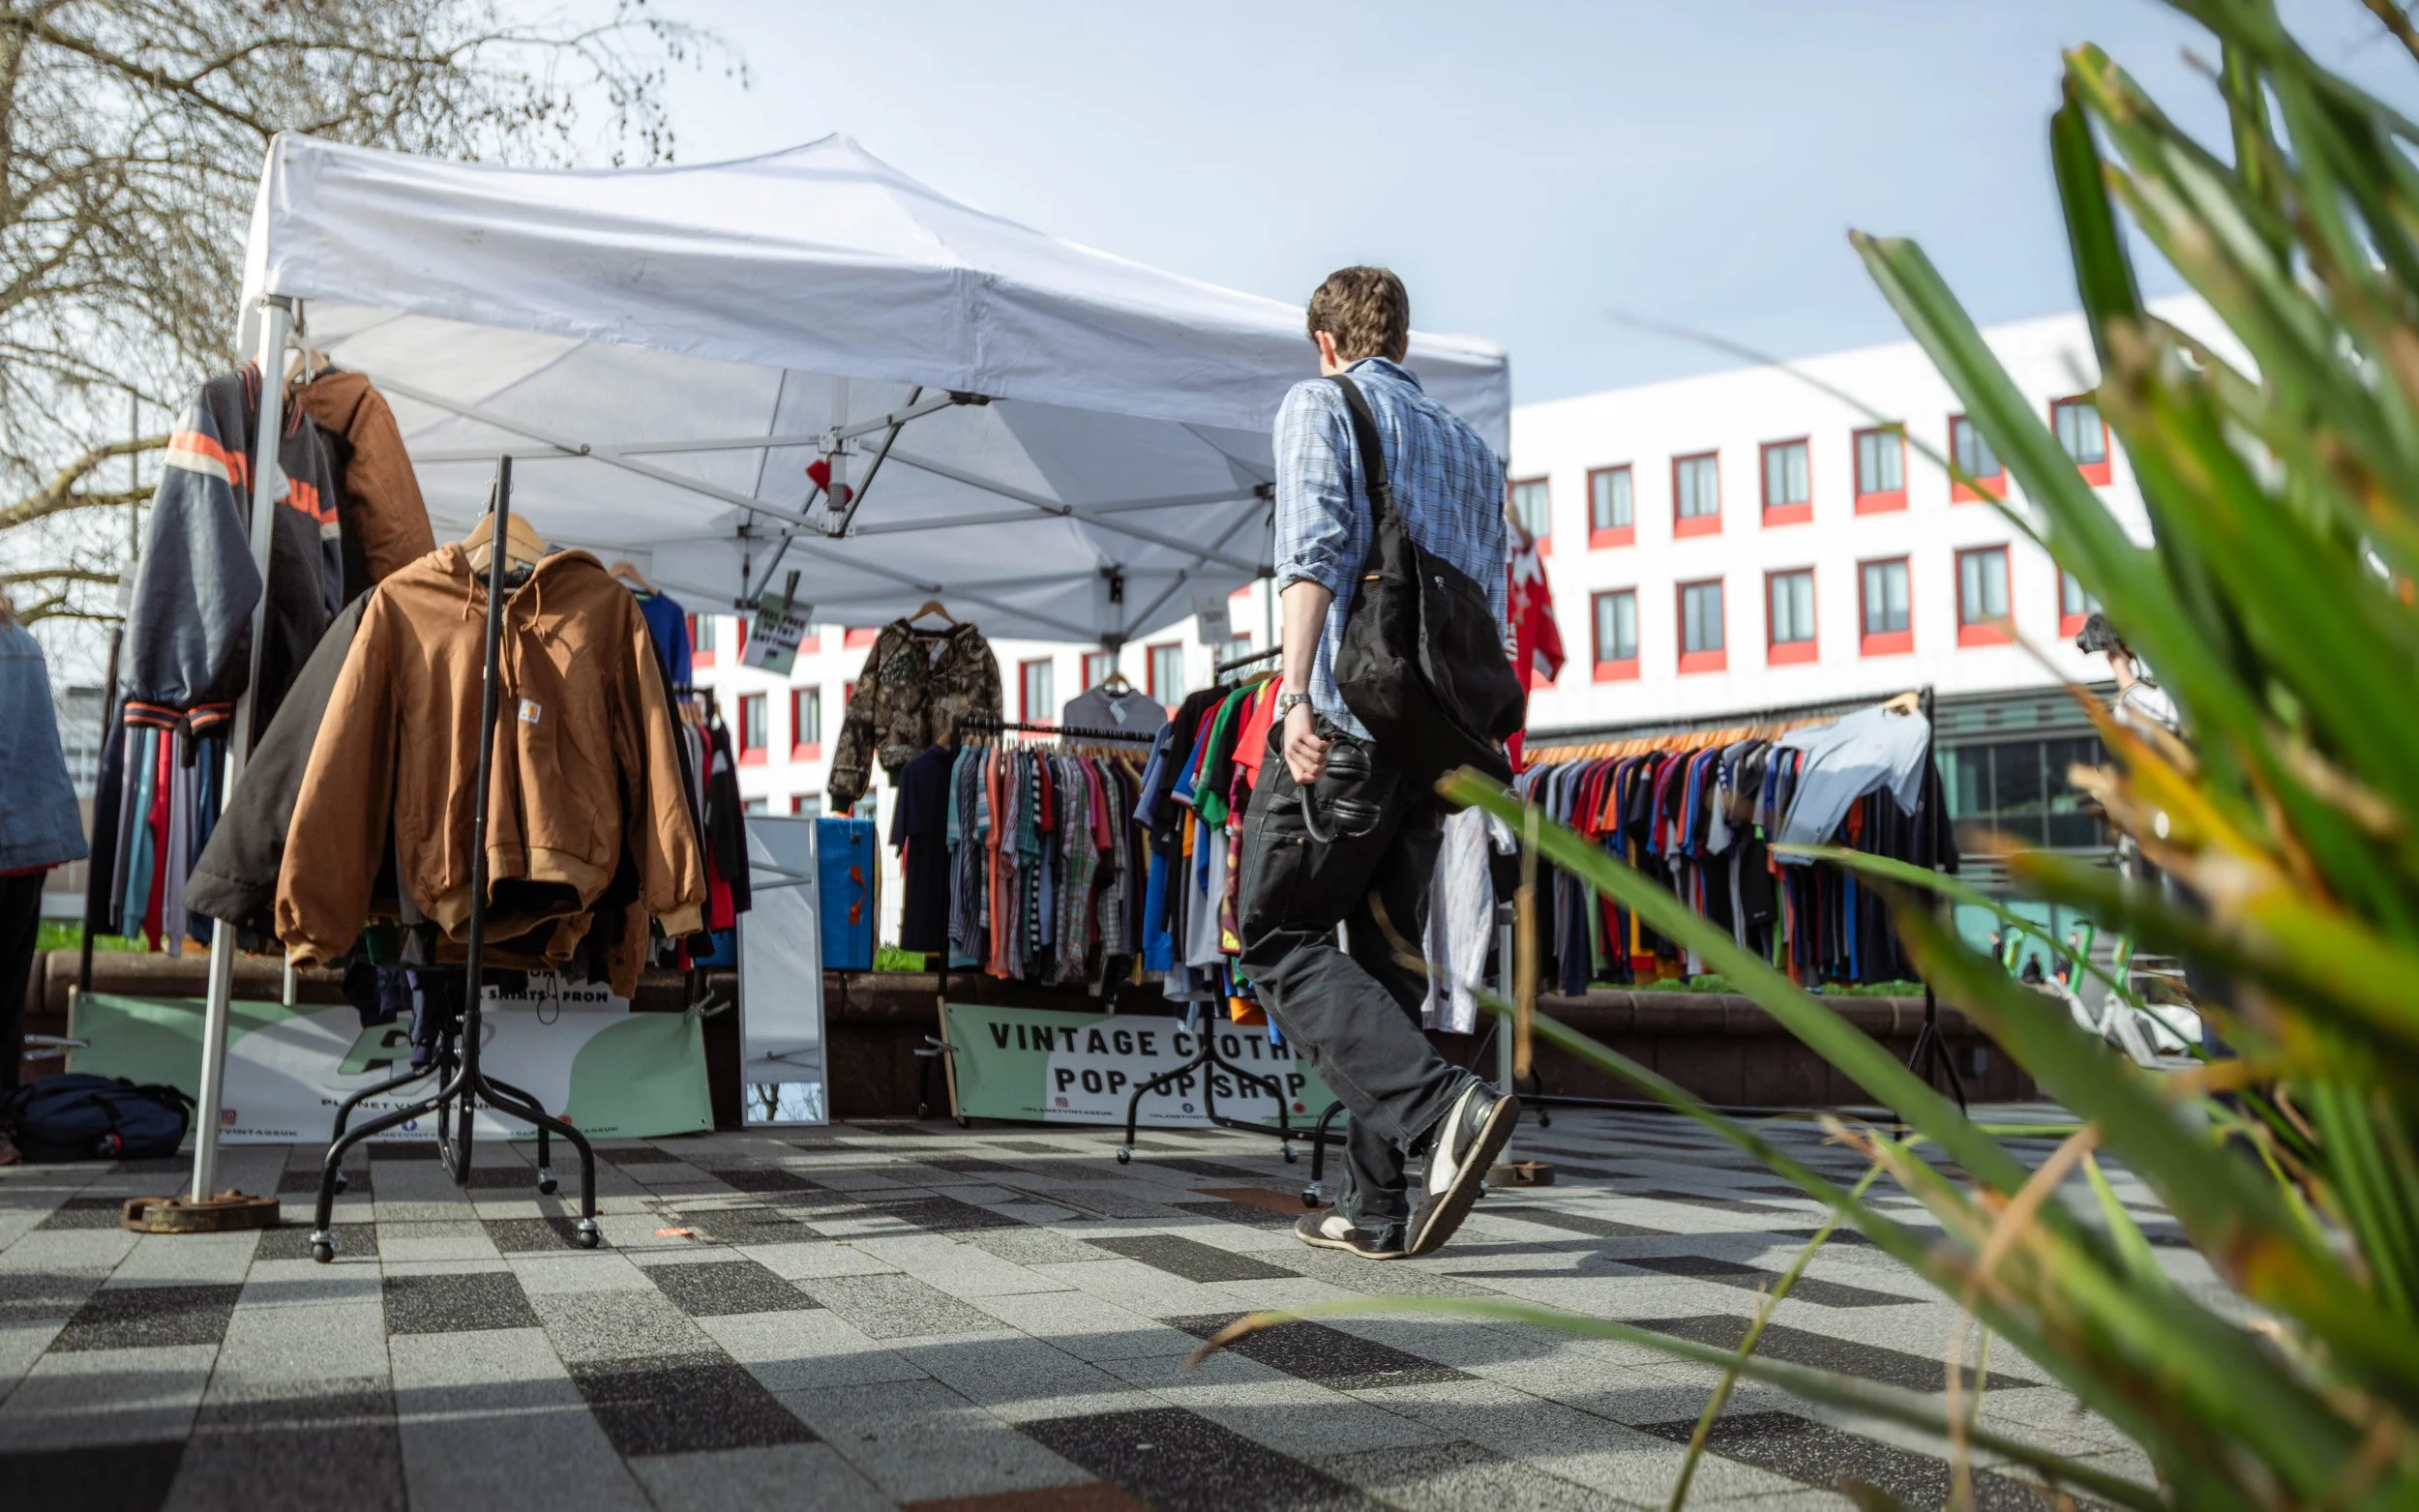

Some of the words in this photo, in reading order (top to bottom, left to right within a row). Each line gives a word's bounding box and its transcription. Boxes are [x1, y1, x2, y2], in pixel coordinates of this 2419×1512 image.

[562, 991, 608, 1003] FROM
[988, 1022, 1158, 1056] VINTAGE
[1055, 1067, 1197, 1098] POP-UP
[1212, 1072, 1305, 1099] SHOP
[321, 1098, 389, 1111] PLNET
